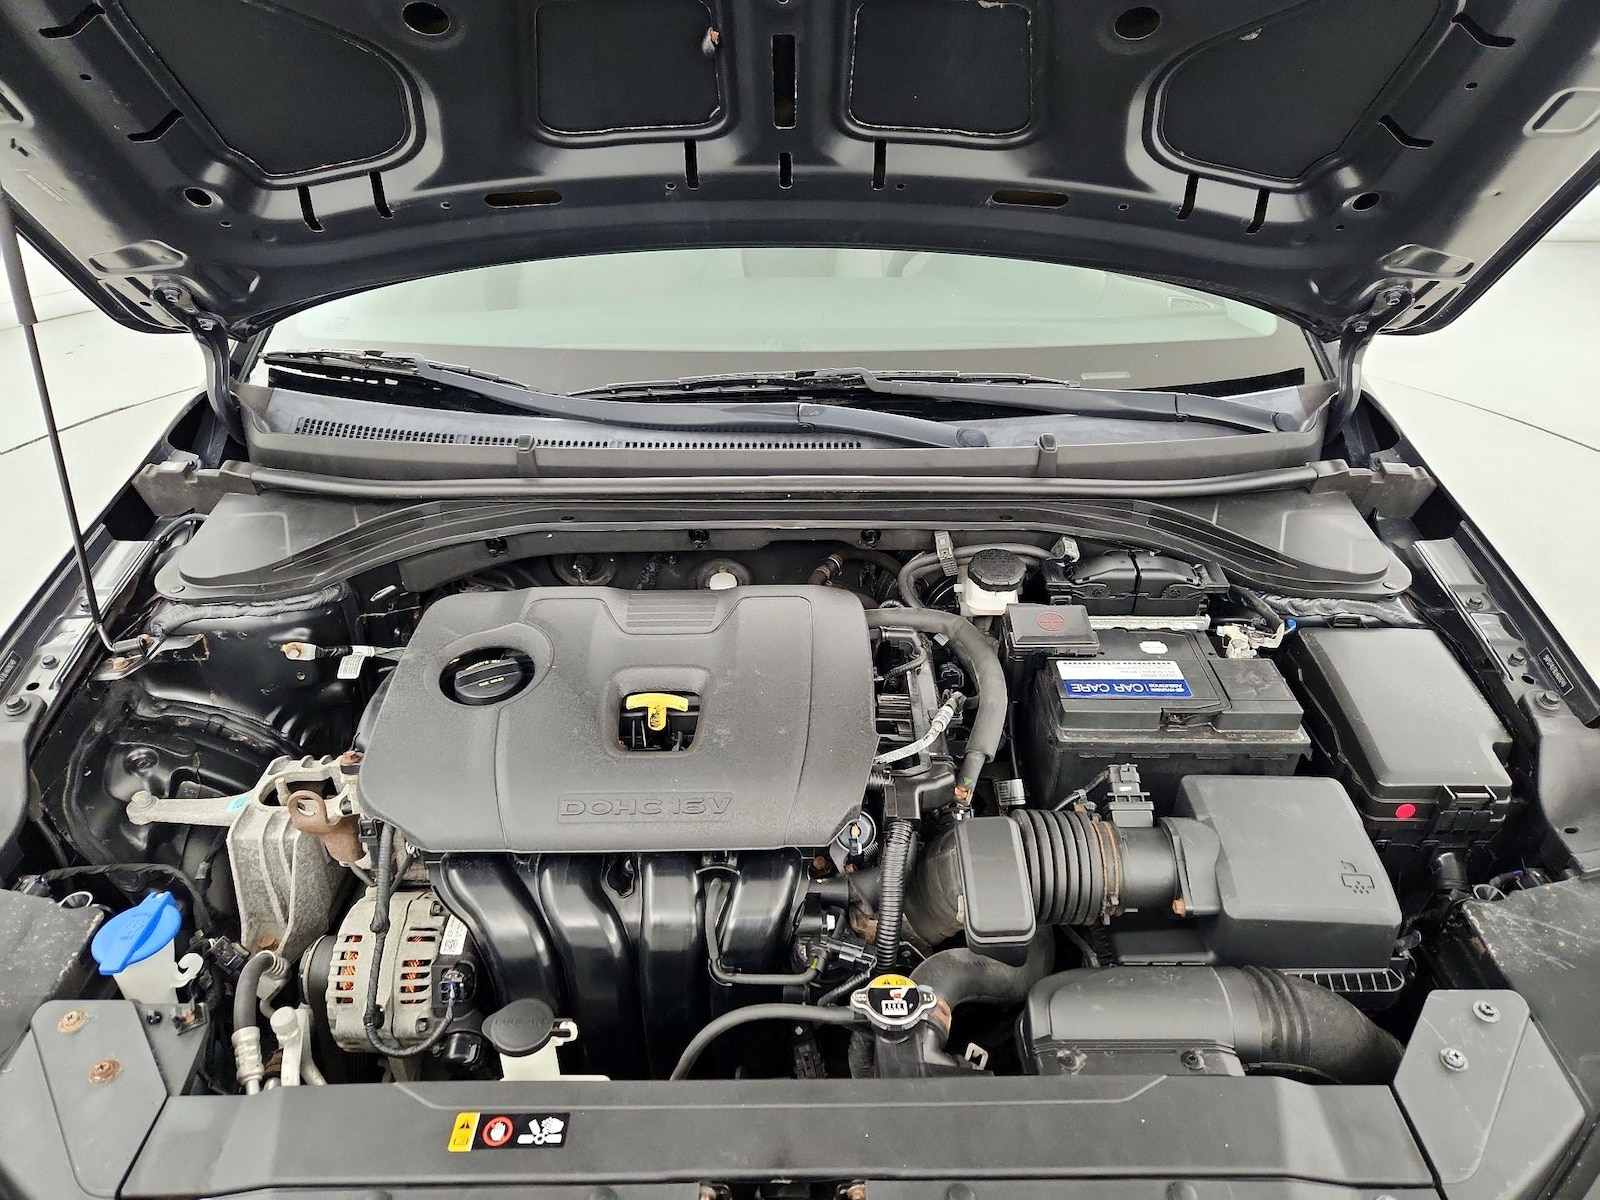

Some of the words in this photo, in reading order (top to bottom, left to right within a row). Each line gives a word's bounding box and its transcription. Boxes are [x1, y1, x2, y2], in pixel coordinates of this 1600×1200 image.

[1070, 683, 1110, 692] CARE
[1113, 683, 1144, 692] CAR
[561, 799, 663, 815] DOHC
[673, 797, 733, 814] 16V
